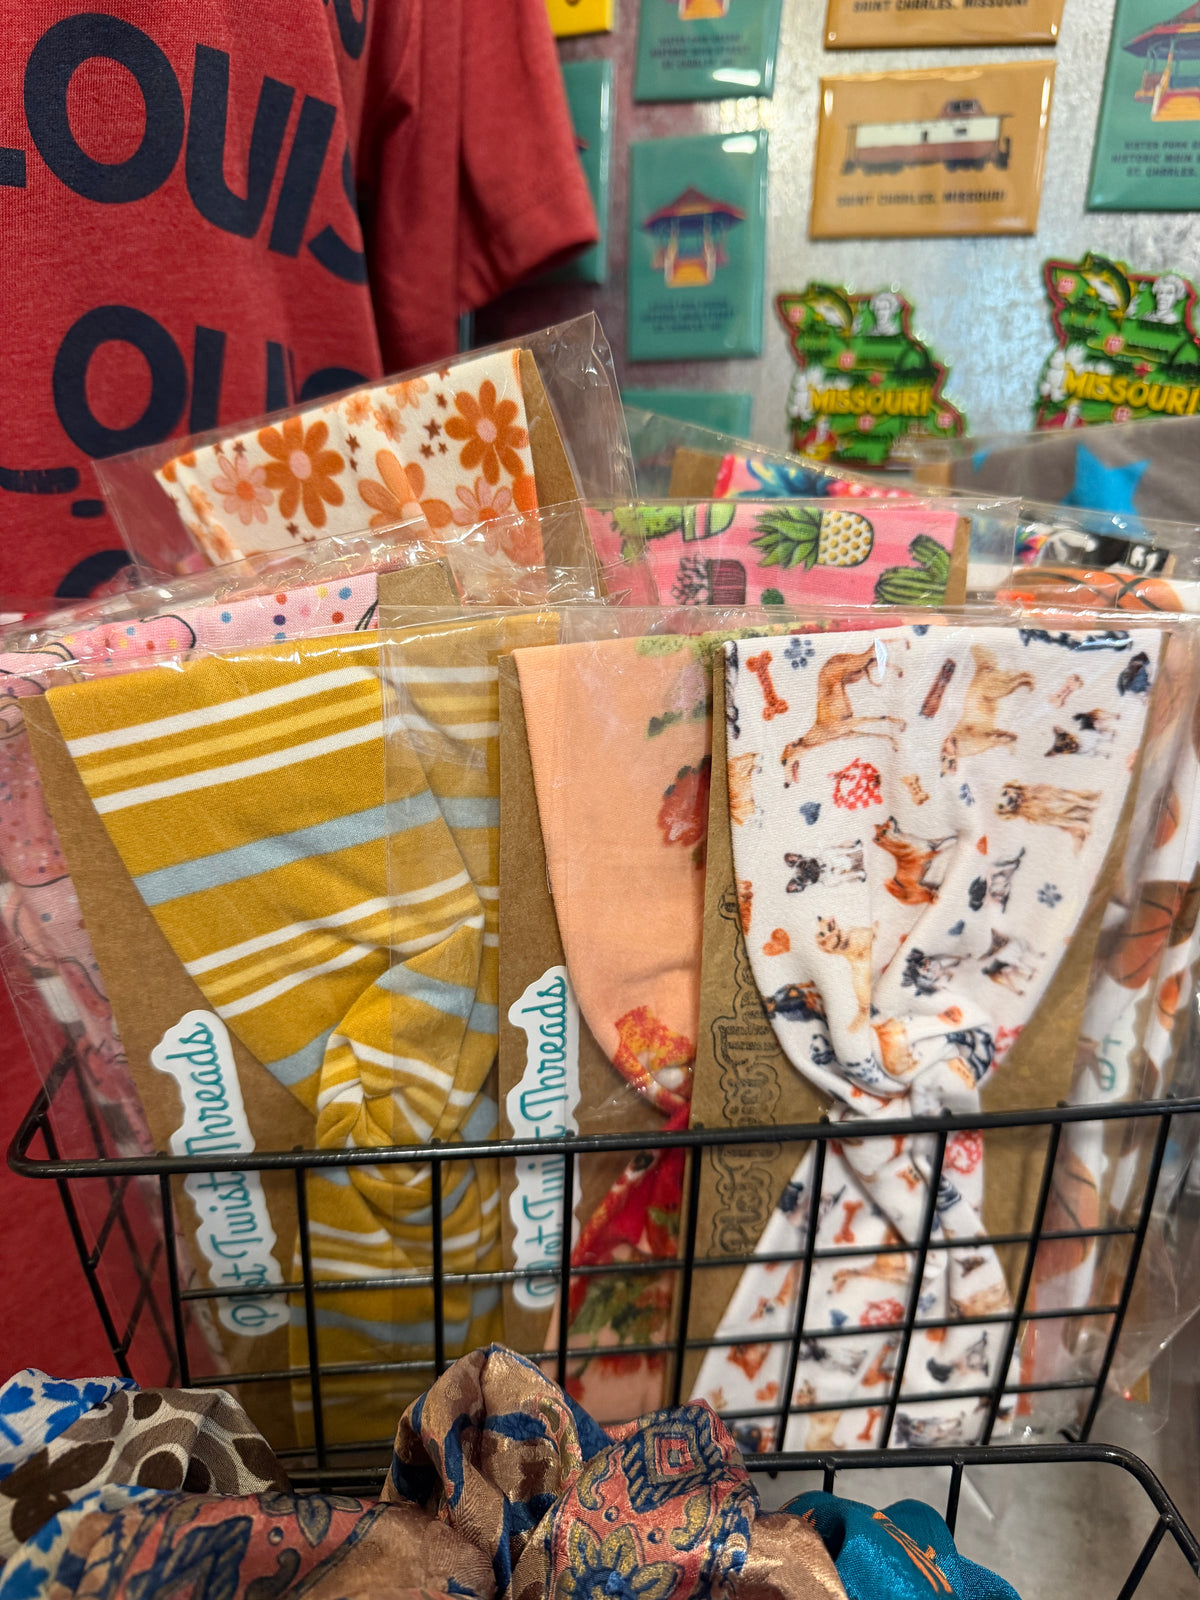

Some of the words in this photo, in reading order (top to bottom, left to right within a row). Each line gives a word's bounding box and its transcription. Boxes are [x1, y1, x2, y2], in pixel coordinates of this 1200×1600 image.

[809, 385, 932, 416] MISSOURI
[1063, 365, 1200, 415] MISSOURI
[165, 1021, 242, 1157] Threads
[519, 975, 569, 1122] Threads
[196, 1171, 264, 1260] Twist
